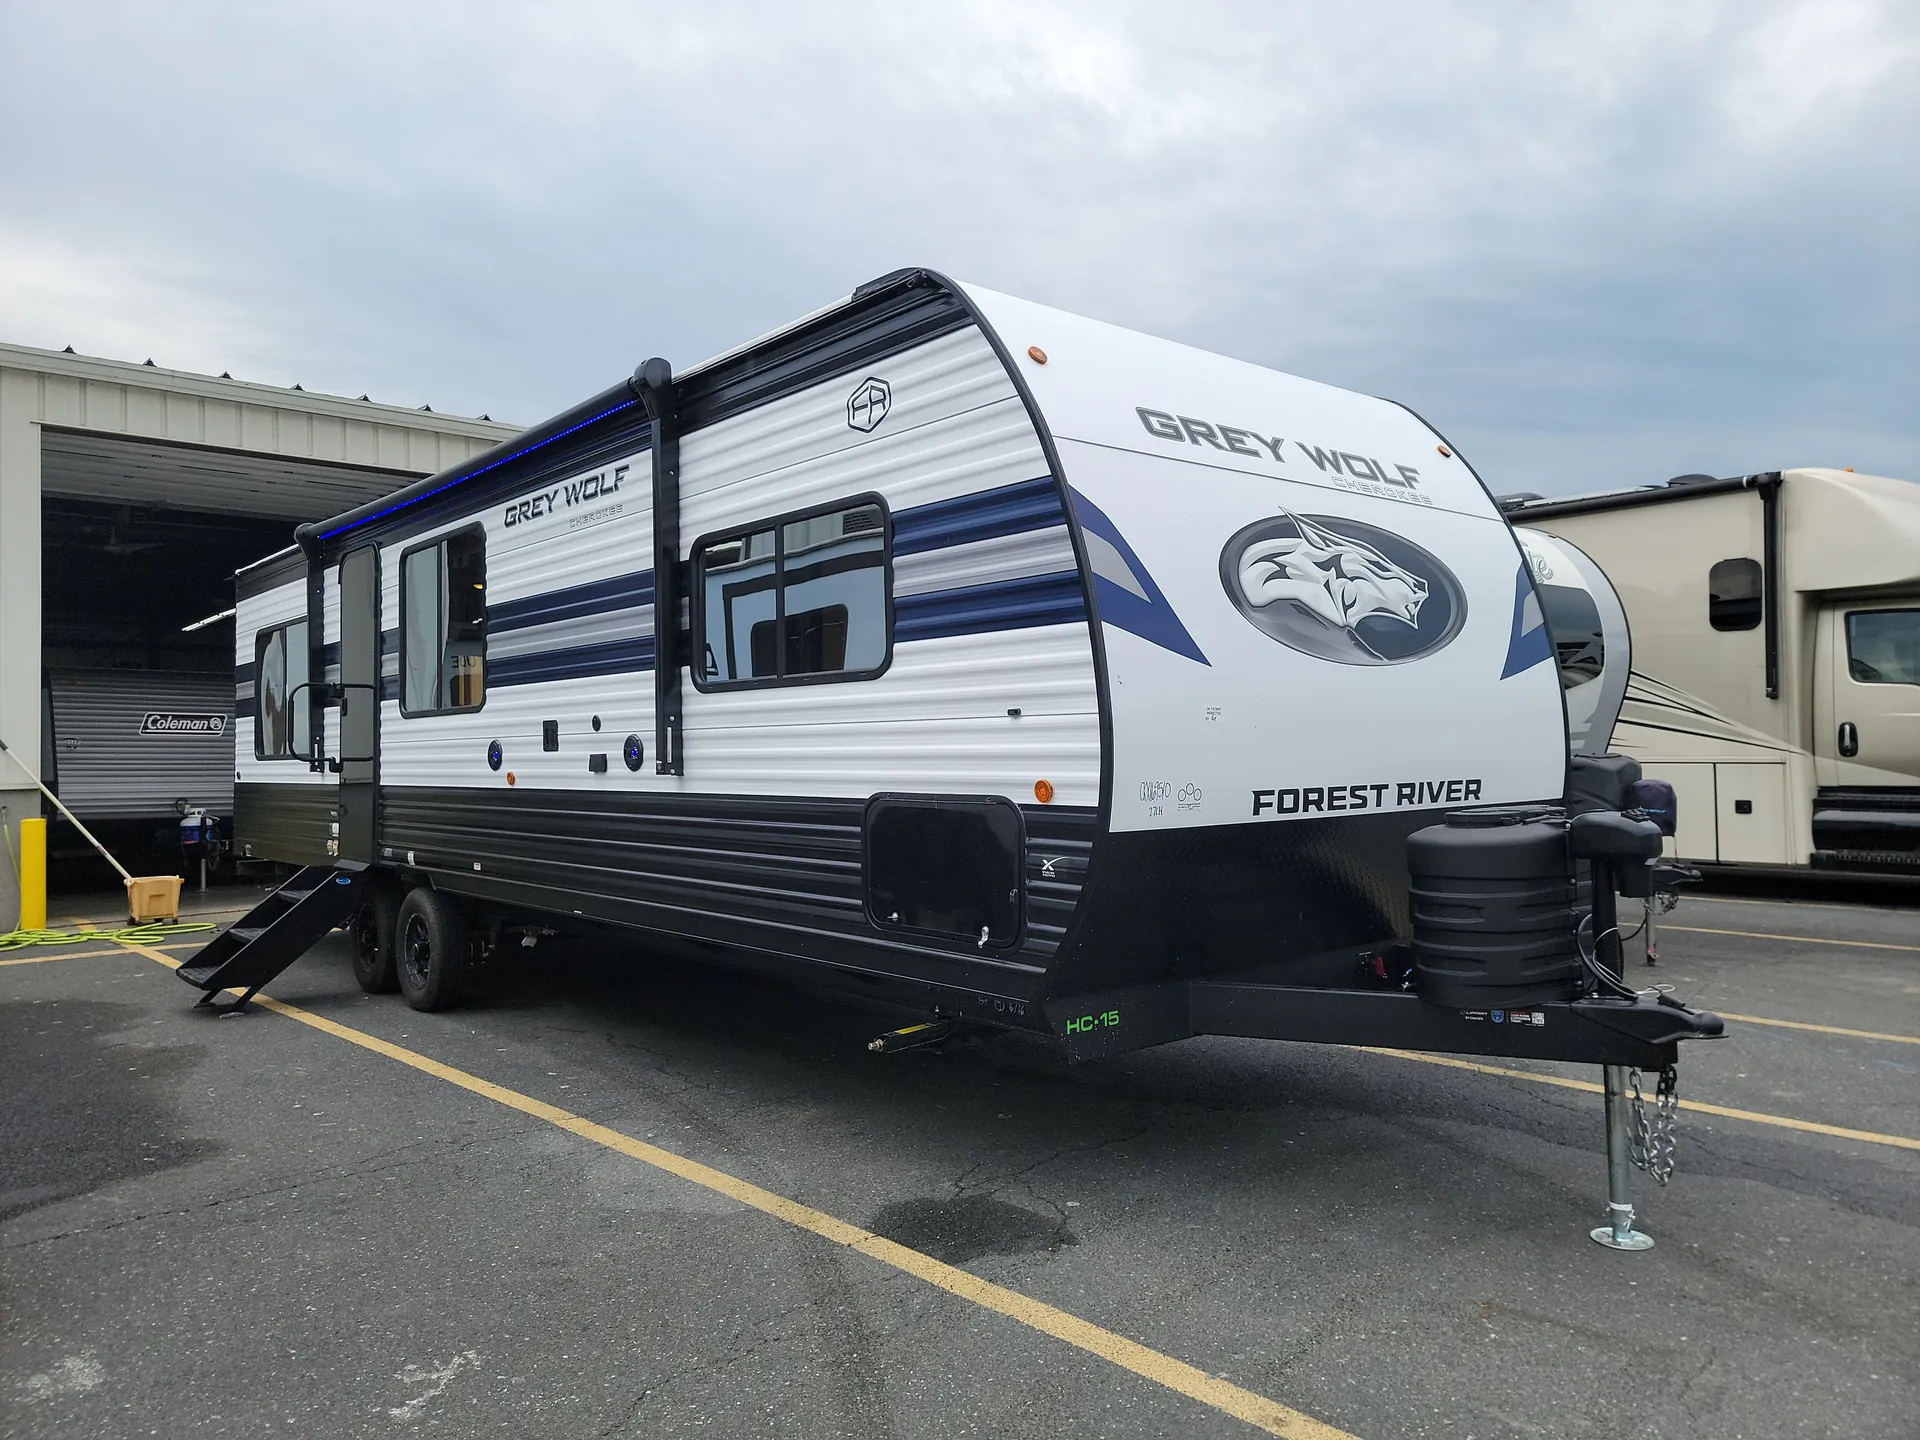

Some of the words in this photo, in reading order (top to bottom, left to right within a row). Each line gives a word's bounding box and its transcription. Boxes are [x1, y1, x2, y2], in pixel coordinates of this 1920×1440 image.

[1135, 406, 1286, 464] GREY
[1294, 441, 1421, 490] WOLF
[504, 488, 560, 529] GREY
[563, 463, 630, 508] WOLF
[1331, 475, 1433, 506] CHEROKEE
[568, 503, 624, 528] CHEROKEE
[147, 714, 208, 731] Coleman
[1251, 783, 1390, 816] FOREST
[1396, 778, 1482, 806] RIVER
